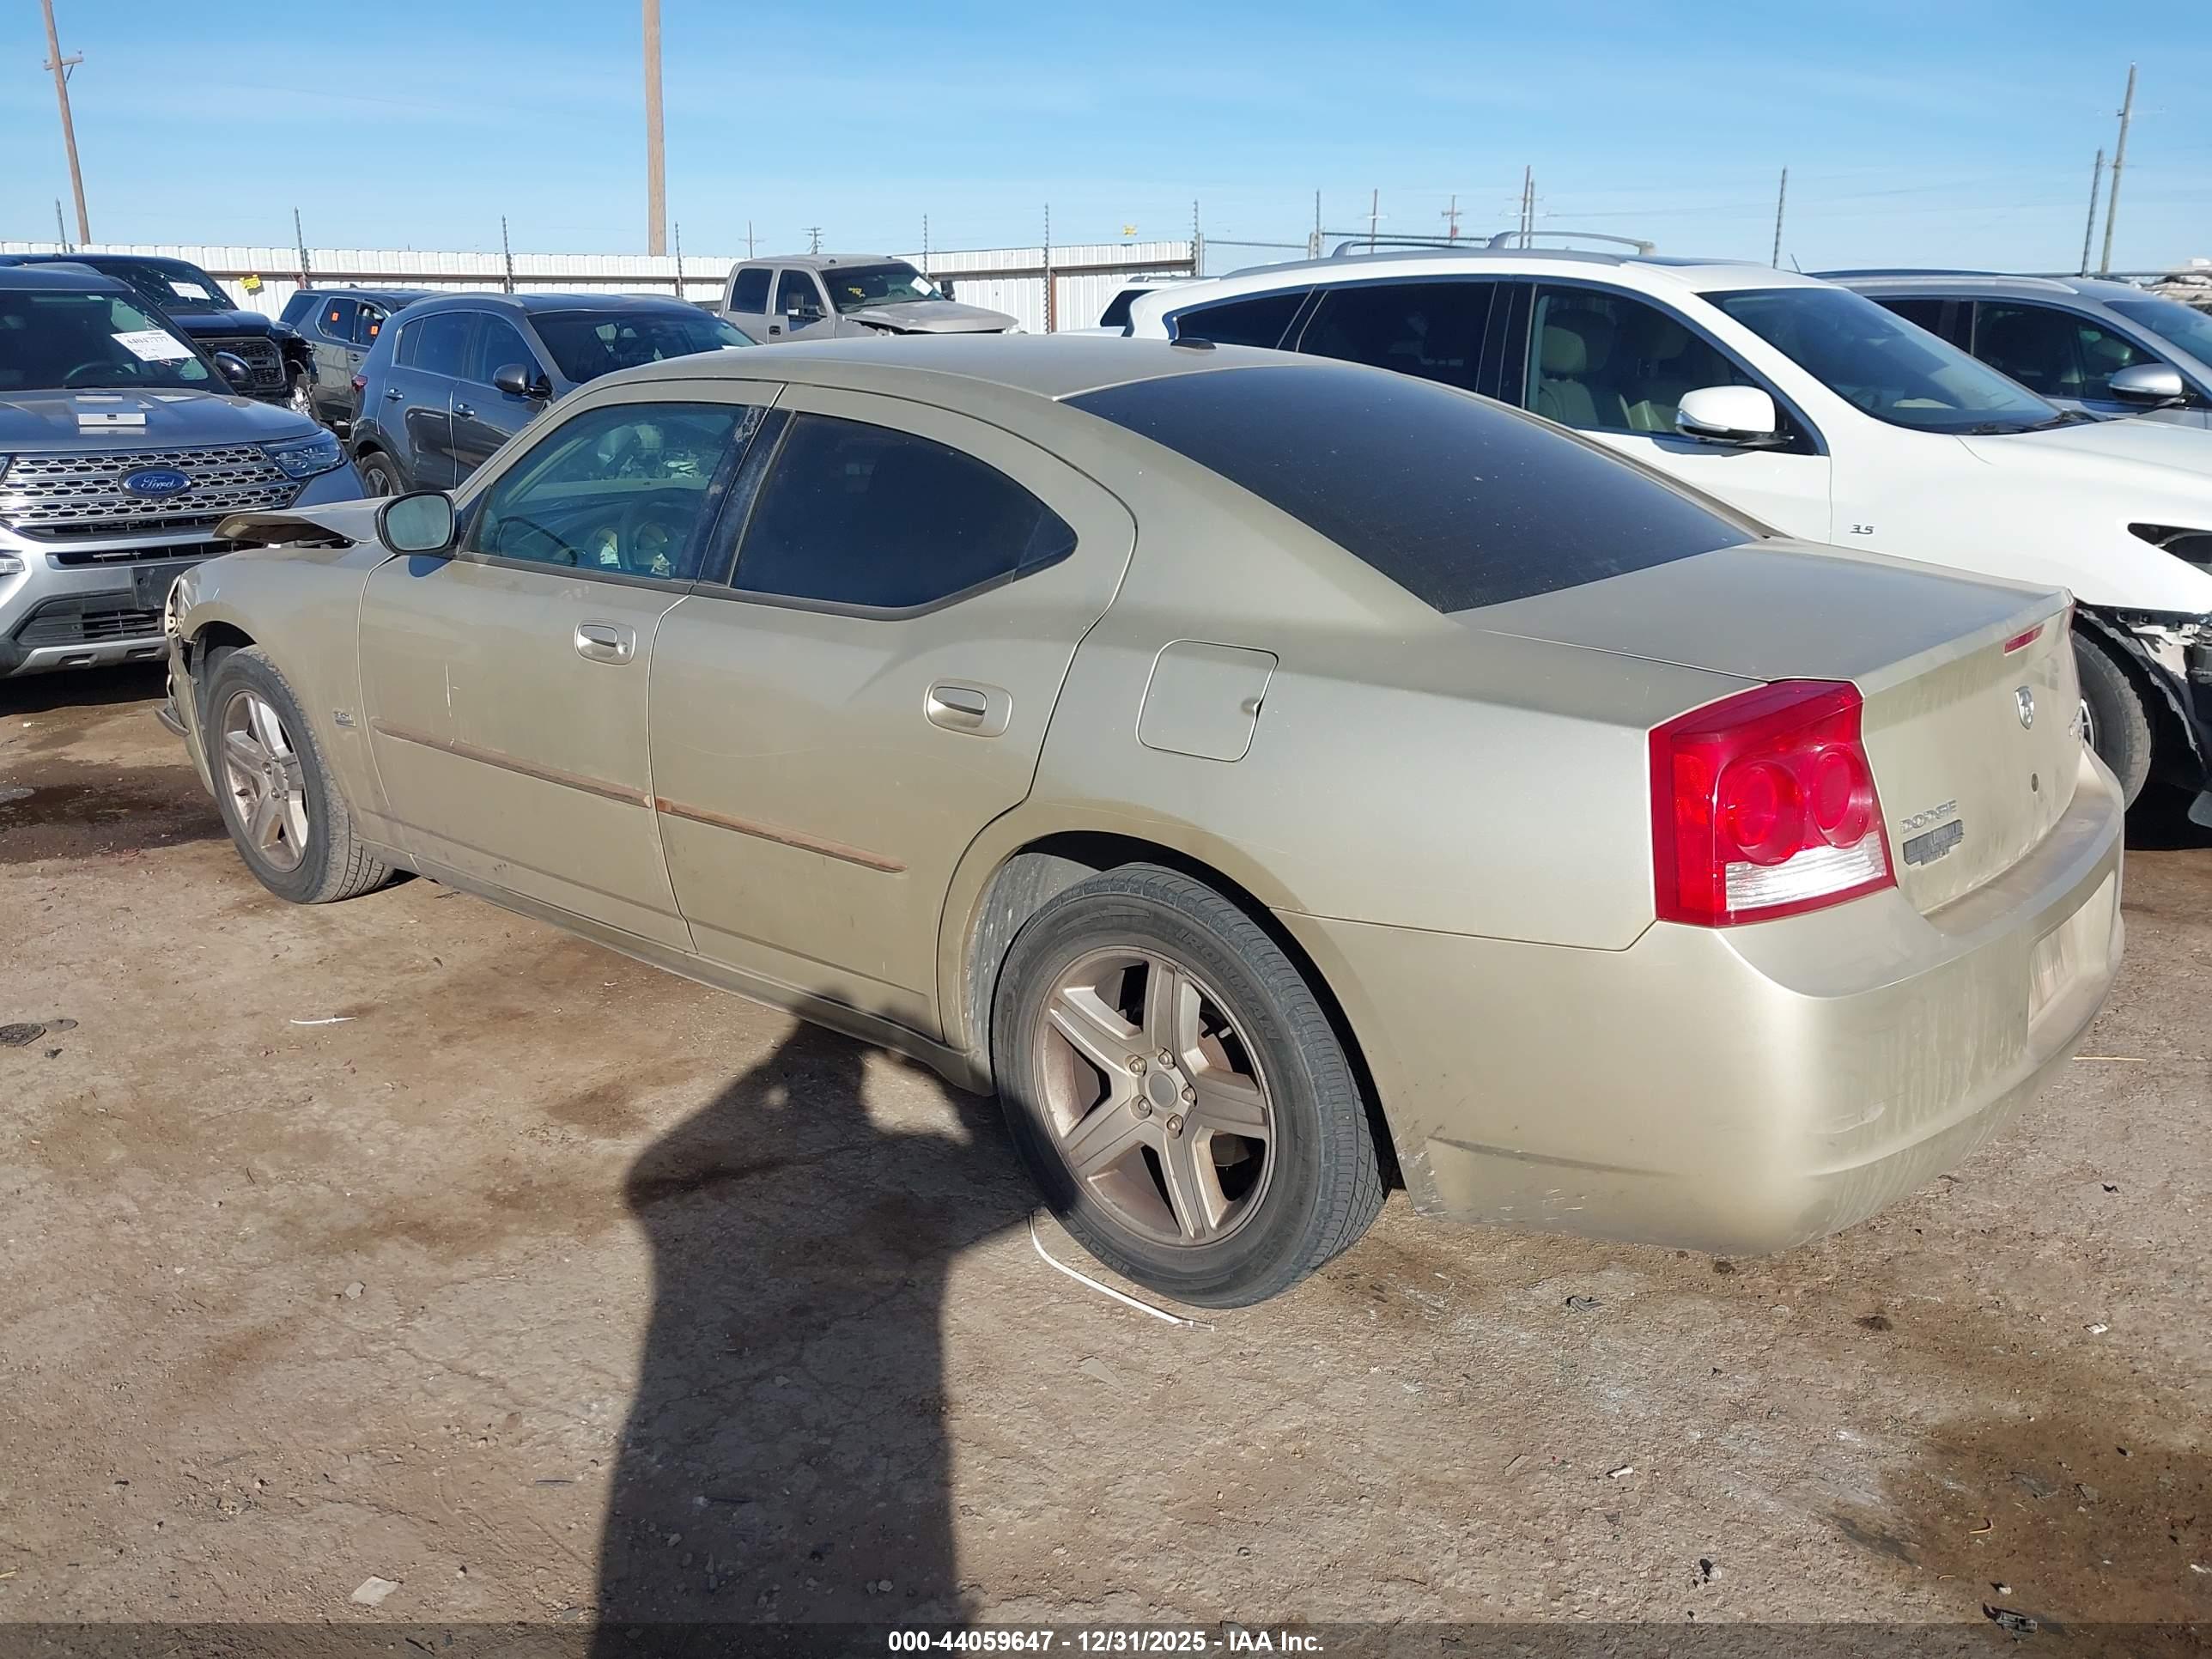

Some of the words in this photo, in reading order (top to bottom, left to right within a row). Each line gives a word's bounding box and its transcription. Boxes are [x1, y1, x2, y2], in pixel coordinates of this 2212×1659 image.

[141, 476, 176, 489] Ford
[1899, 799, 1956, 835] DODGE
[1176, 927, 1280, 1040] IRONMAN
